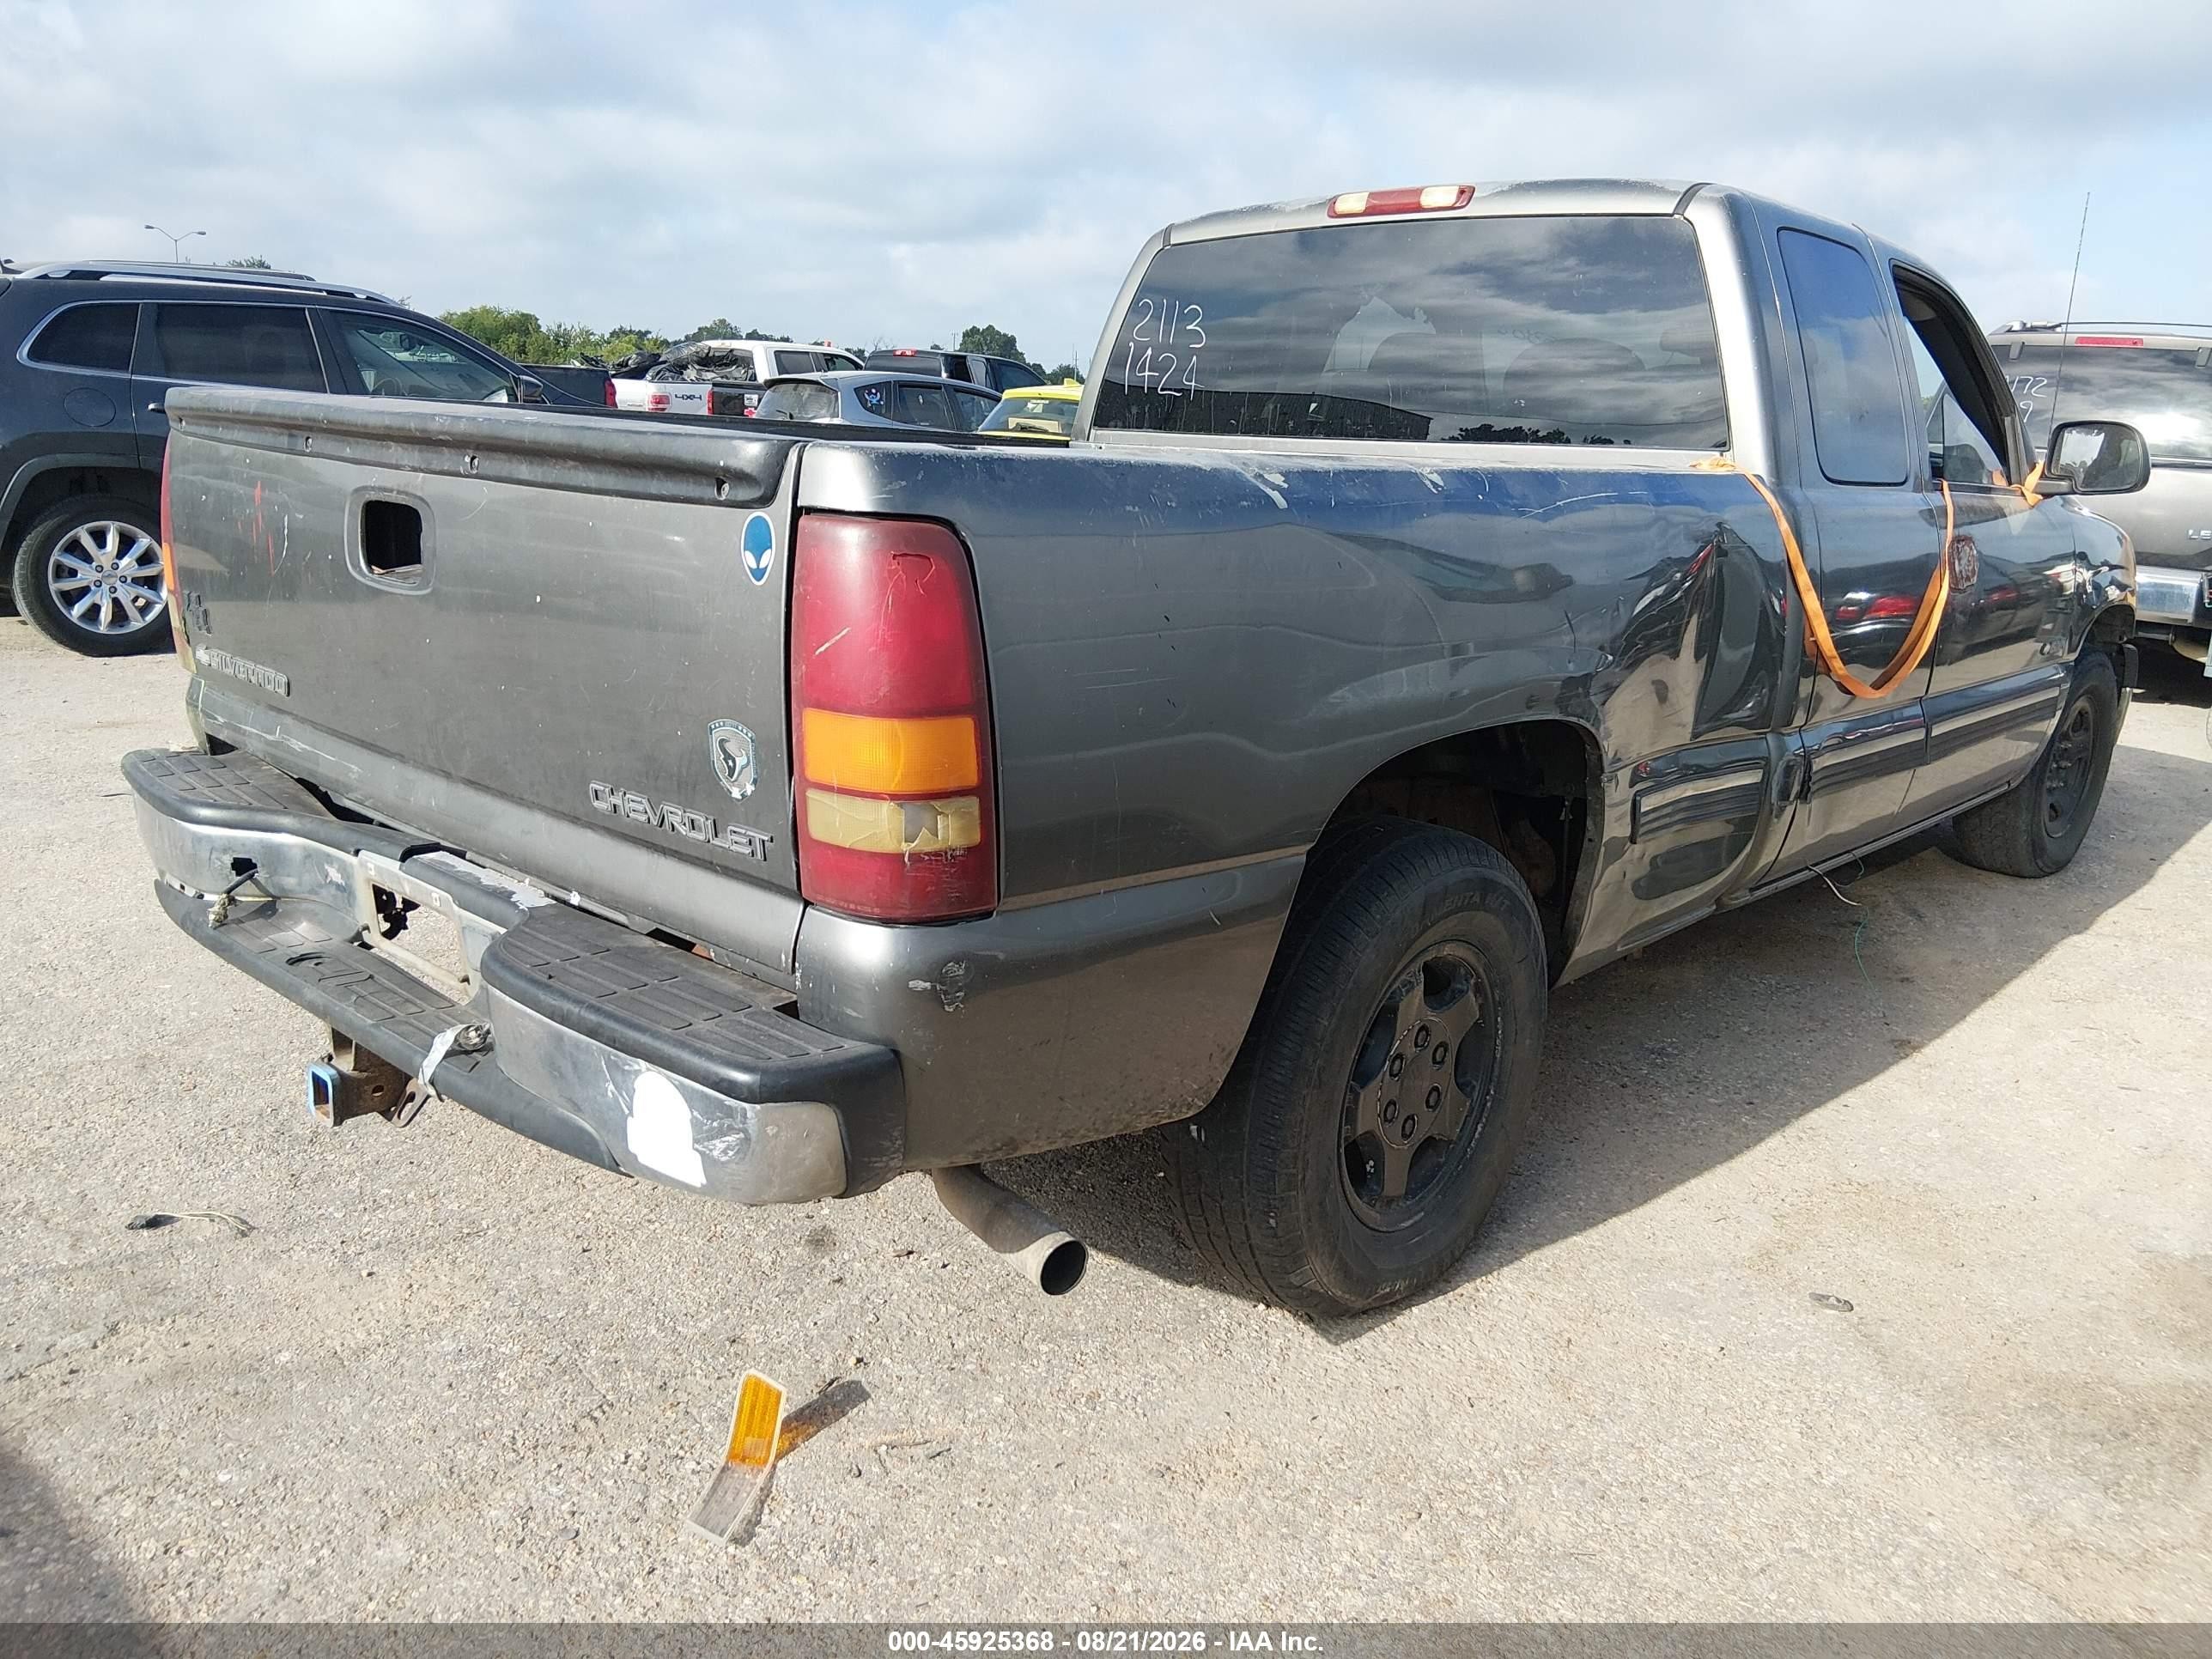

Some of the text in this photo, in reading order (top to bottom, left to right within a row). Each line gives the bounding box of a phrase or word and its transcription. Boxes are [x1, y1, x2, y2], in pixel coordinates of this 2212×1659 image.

[1133, 298, 1206, 348] 2113
[1124, 341, 1205, 402] 1424
[211, 651, 291, 698] SILVERADO
[589, 779, 775, 862] CHEVROLET
